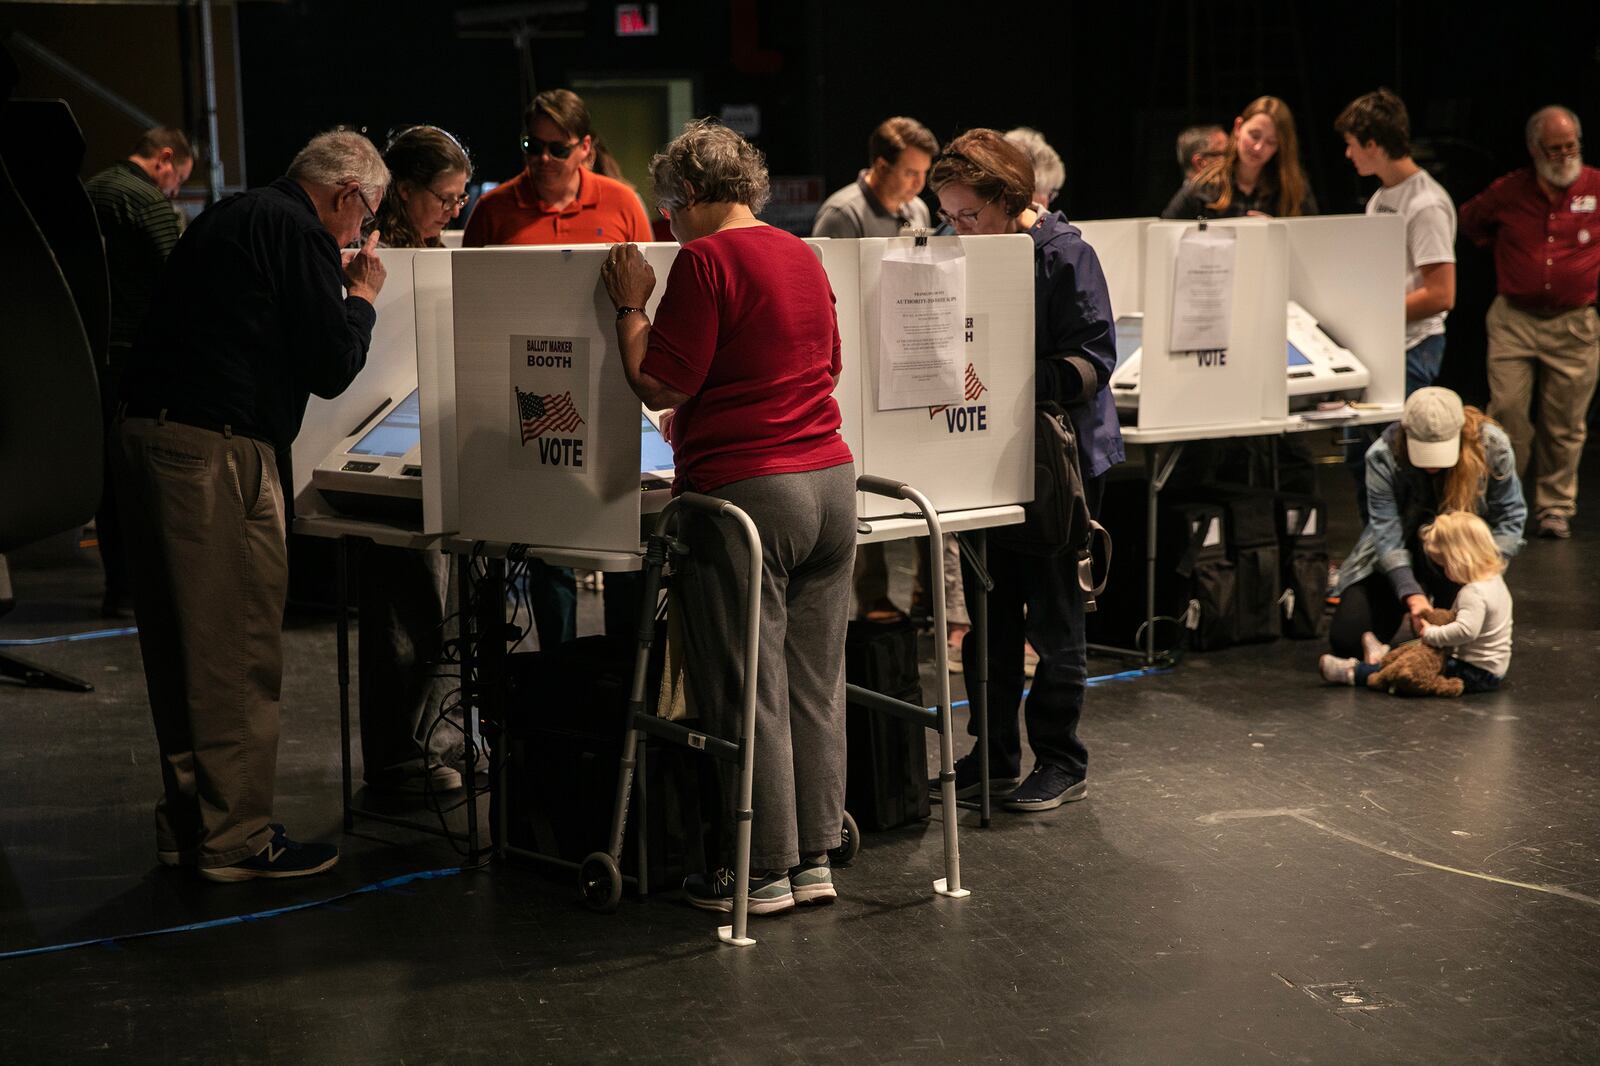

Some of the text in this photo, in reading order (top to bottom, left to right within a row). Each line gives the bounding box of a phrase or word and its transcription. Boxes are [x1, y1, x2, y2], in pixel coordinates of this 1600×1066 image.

[527, 340, 573, 353] BALLOT MARKER
[527, 355, 572, 368] BOOTH
[1197, 350, 1226, 367] VOTE
[945, 405, 987, 433] VOTE
[538, 437, 583, 467] VOTE
